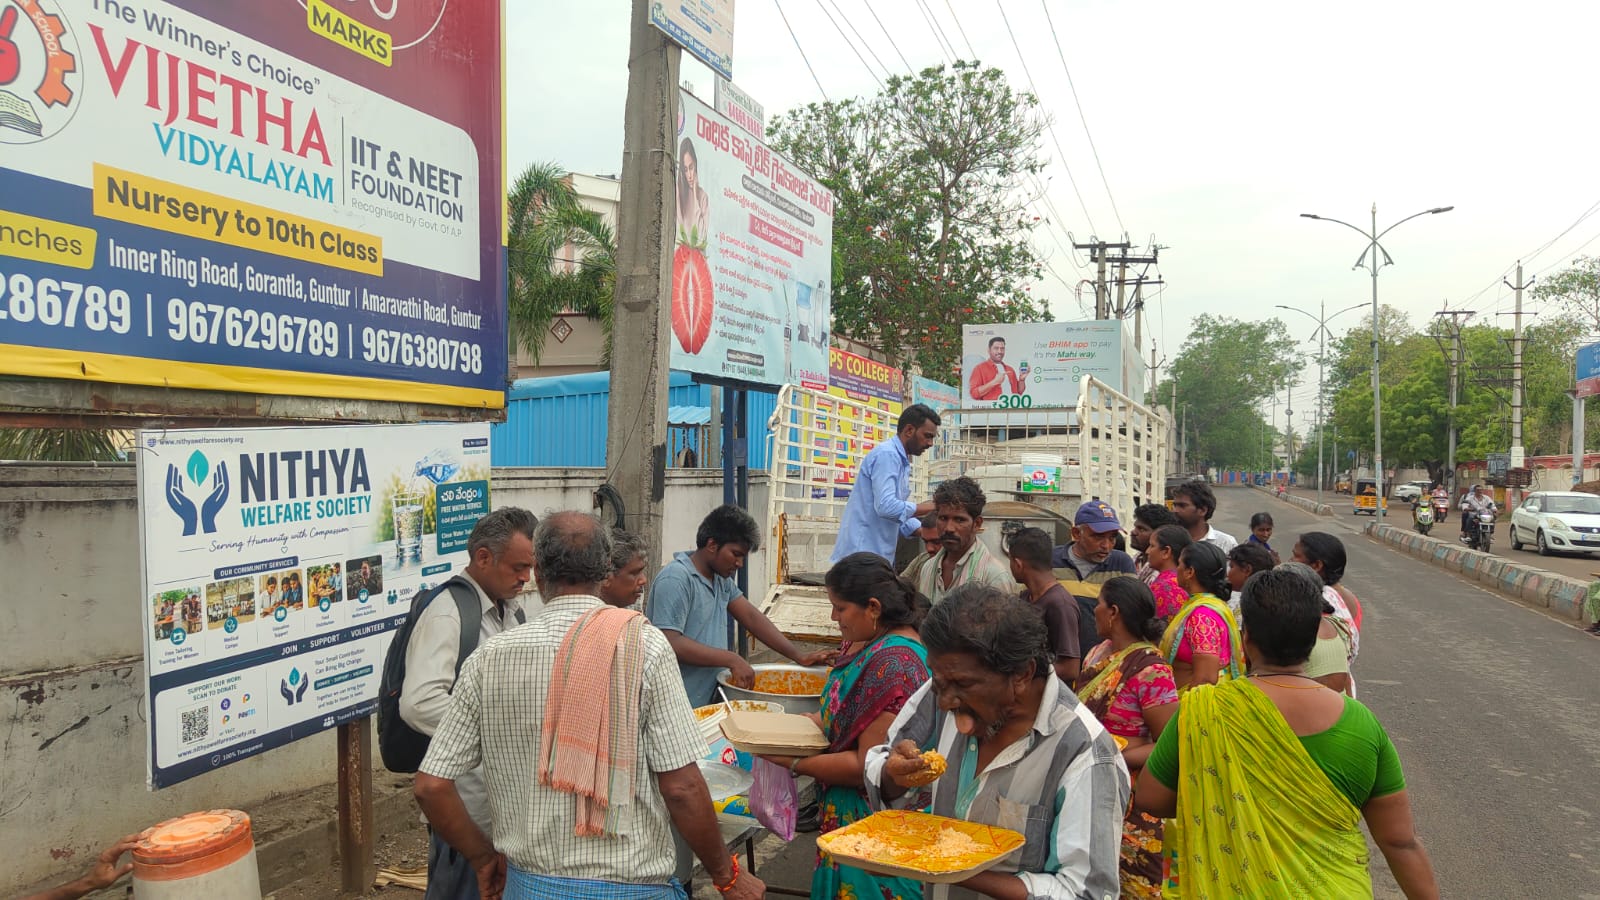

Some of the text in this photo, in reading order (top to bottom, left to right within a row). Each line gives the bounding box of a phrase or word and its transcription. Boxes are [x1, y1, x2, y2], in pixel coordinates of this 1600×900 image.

[32, 11, 59, 57] SCHOOL
[143, 9, 242, 66] Winner's
[312, 5, 389, 60] MARKS
[86, 22, 333, 167] VIJETHA
[697, 112, 730, 152] రాధిక
[152, 122, 334, 204] VIDYALAYAM
[351, 136, 463, 198] IIT & NEET
[351, 170, 463, 223] FOUNDATION
[351, 198, 404, 220] Recognised
[406, 213, 417, 227] by
[419, 217, 438, 232] Govt.
[107, 176, 378, 264] Nursery to 10th Class
[109, 238, 350, 308] Inner Ring Road, Gorantla, Guntur
[361, 288, 482, 330] Amaravathi Road, Guntur
[167, 298, 338, 358] 9676296789
[362, 327, 482, 375] 9676380798
[1034, 341, 1048, 349] Use
[1048, 340, 1072, 348] BHIM
[846, 355, 890, 384] COLLEGE
[159, 437, 244, 446] www.nithyawelfaresociety.org
[239, 448, 371, 504] NITHYA
[240, 495, 372, 528] WELFARE SOCIETY
[208, 527, 350, 553] Serving Humanity with Compassion
[220, 559, 294, 577] OUR COMMUNITY SERVICES
[281, 644, 298, 656] JOIN
[310, 634, 340, 648] SUPPORT
[350, 622, 385, 638] VOLUNTEER
[187, 683, 213, 695] SUPPORT
[193, 692, 208, 701] SCAN
[217, 684, 237, 695] DONATE
[177, 729, 257, 758] www.nithyawelfaresociety.org
[222, 751, 236, 761] 100%
